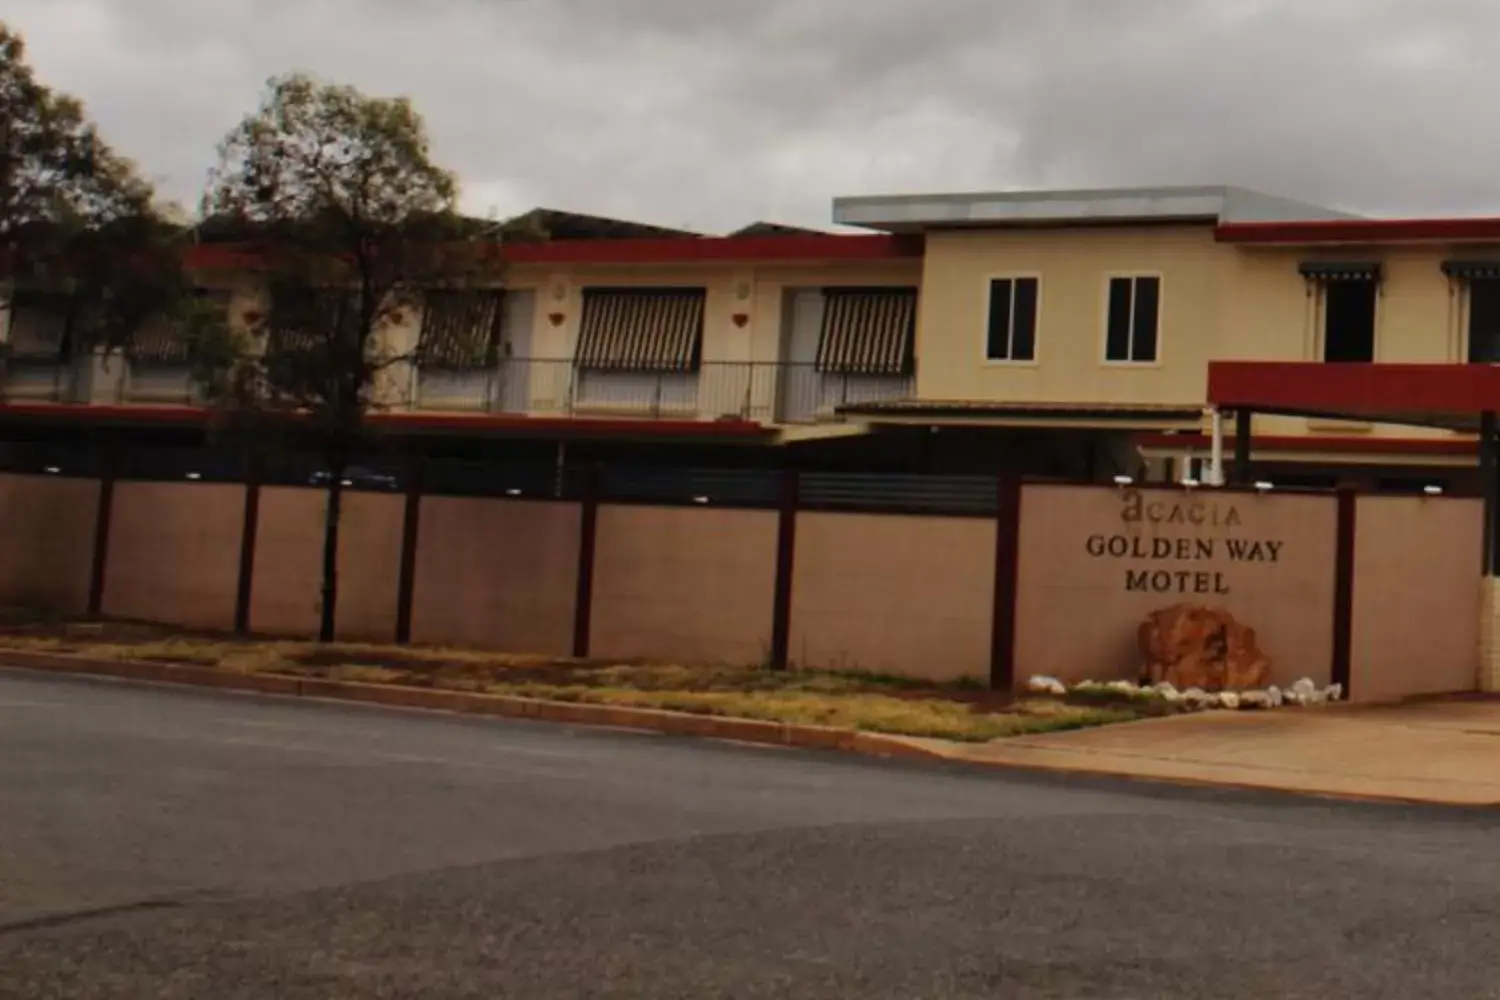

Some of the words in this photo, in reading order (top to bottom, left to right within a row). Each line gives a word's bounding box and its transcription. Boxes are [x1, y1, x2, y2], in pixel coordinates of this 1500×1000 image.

[1086, 535, 1215, 560] GOLDEN
[1226, 539, 1284, 562] WAY
[1125, 569, 1231, 594] MOTEL
